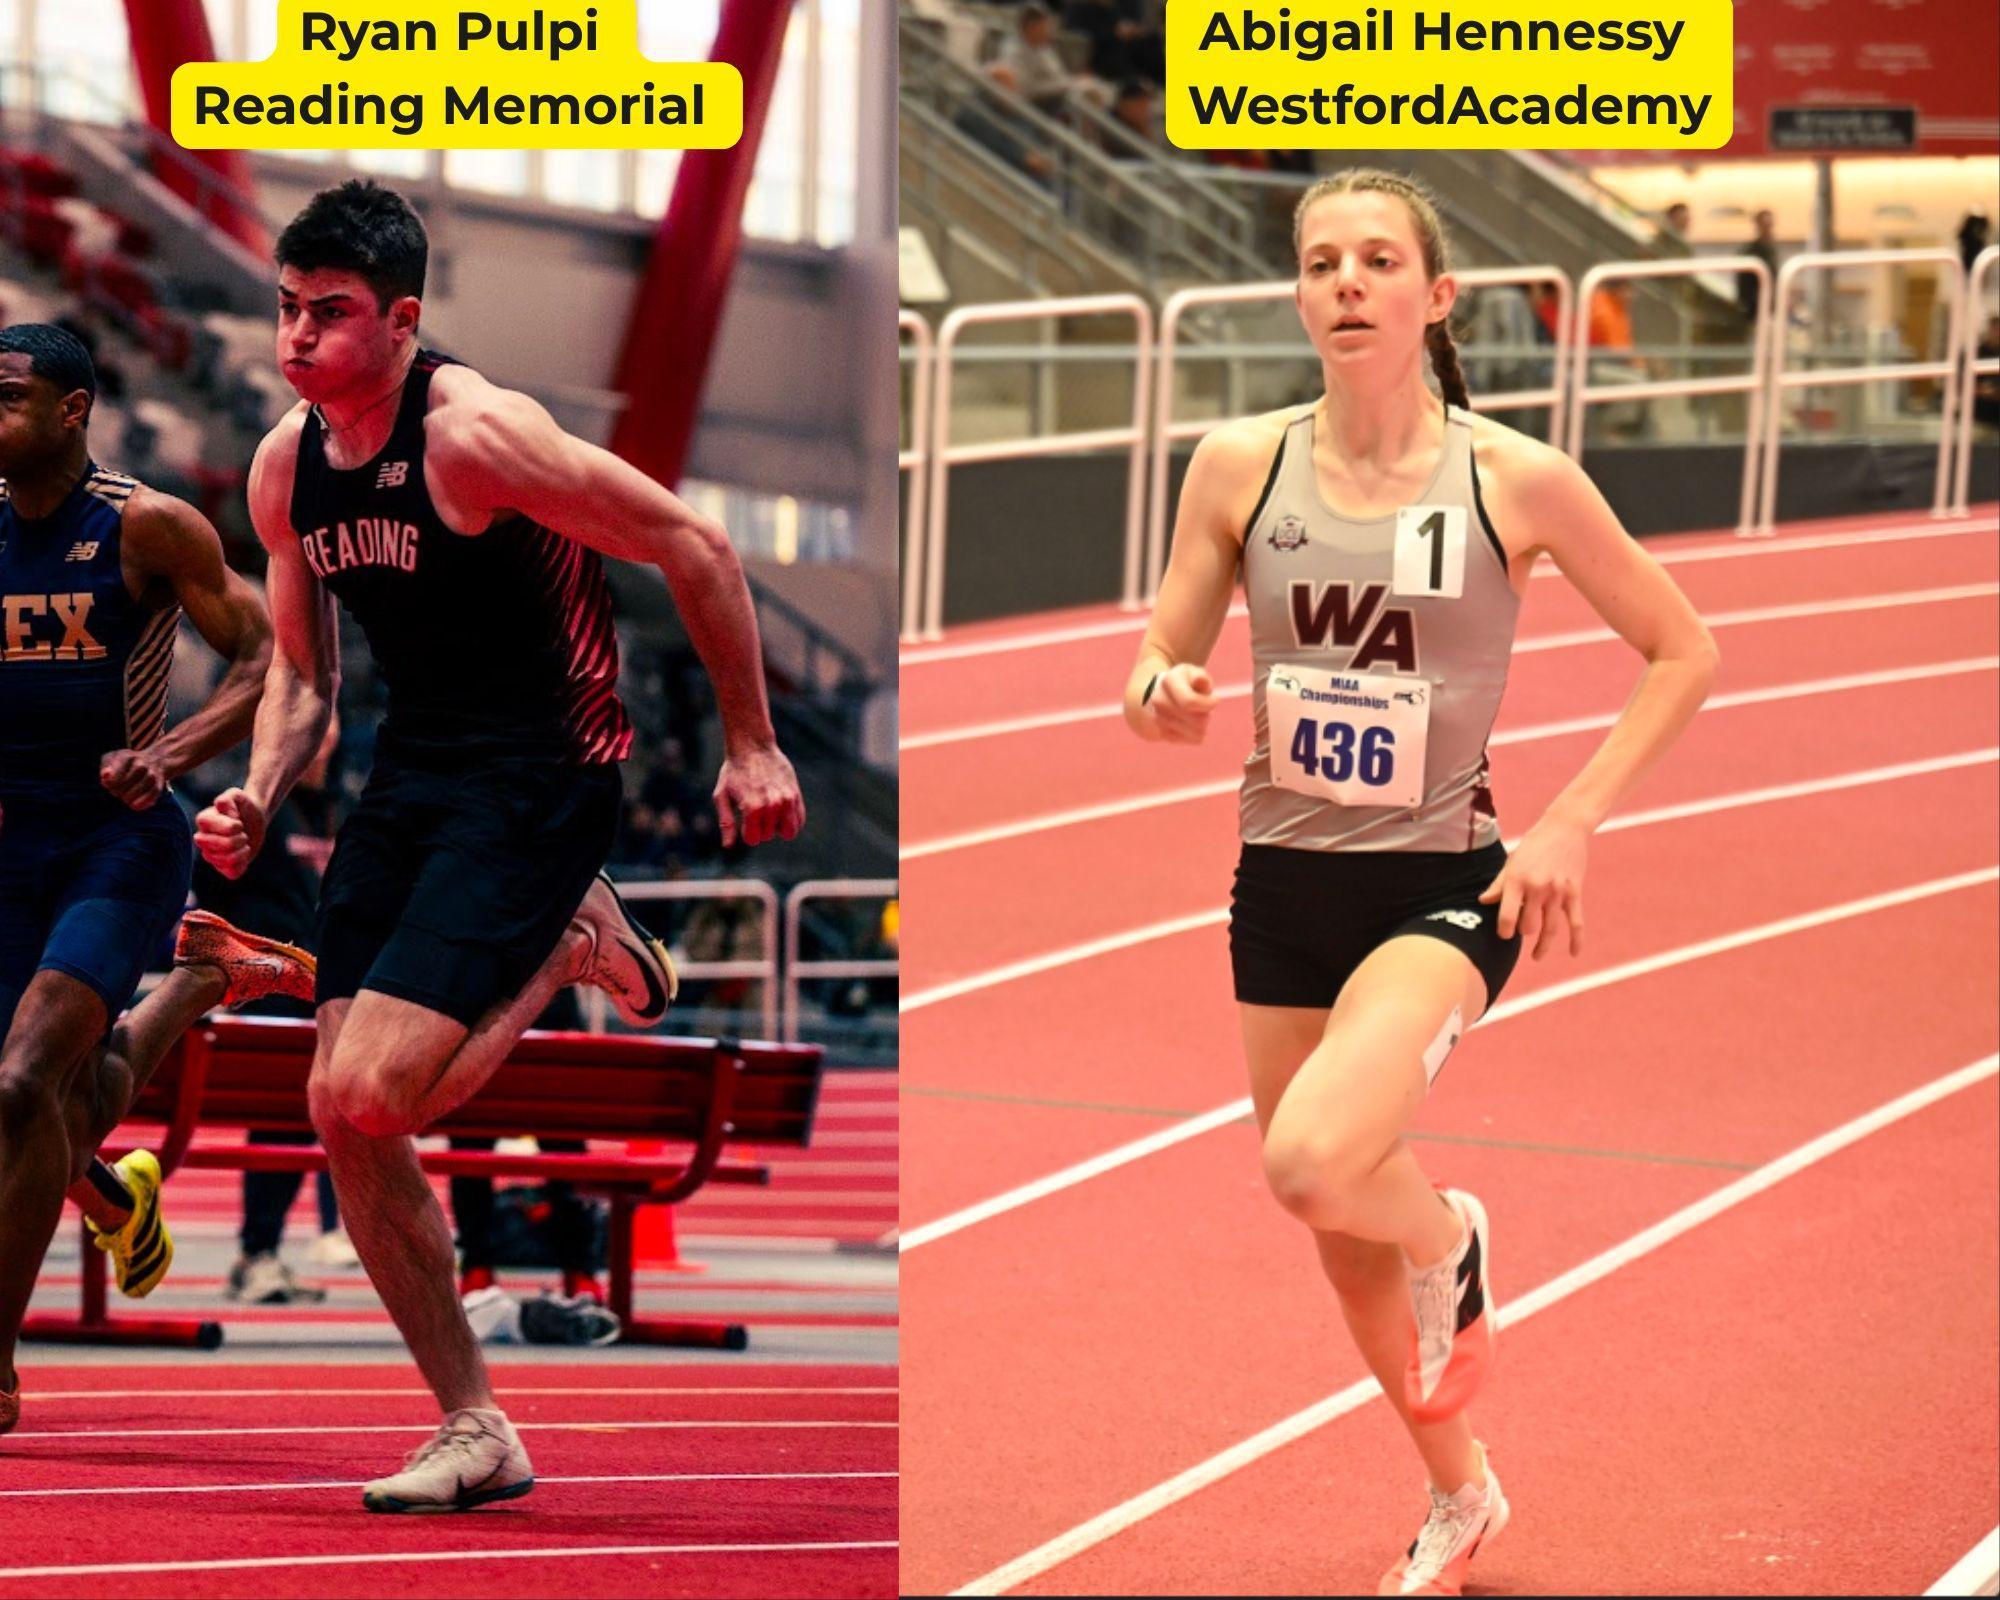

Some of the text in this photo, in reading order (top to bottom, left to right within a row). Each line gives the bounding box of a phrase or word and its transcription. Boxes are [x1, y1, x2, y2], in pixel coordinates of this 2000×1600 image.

[302, 517, 419, 578] READING
[1416, 511, 1446, 591] 1
[0, 592, 108, 662] EX
[1287, 580, 1420, 675] WA
[1299, 687, 1389, 709] Championships
[1331, 677, 1359, 691] MIAA
[1290, 717, 1396, 786] 436
